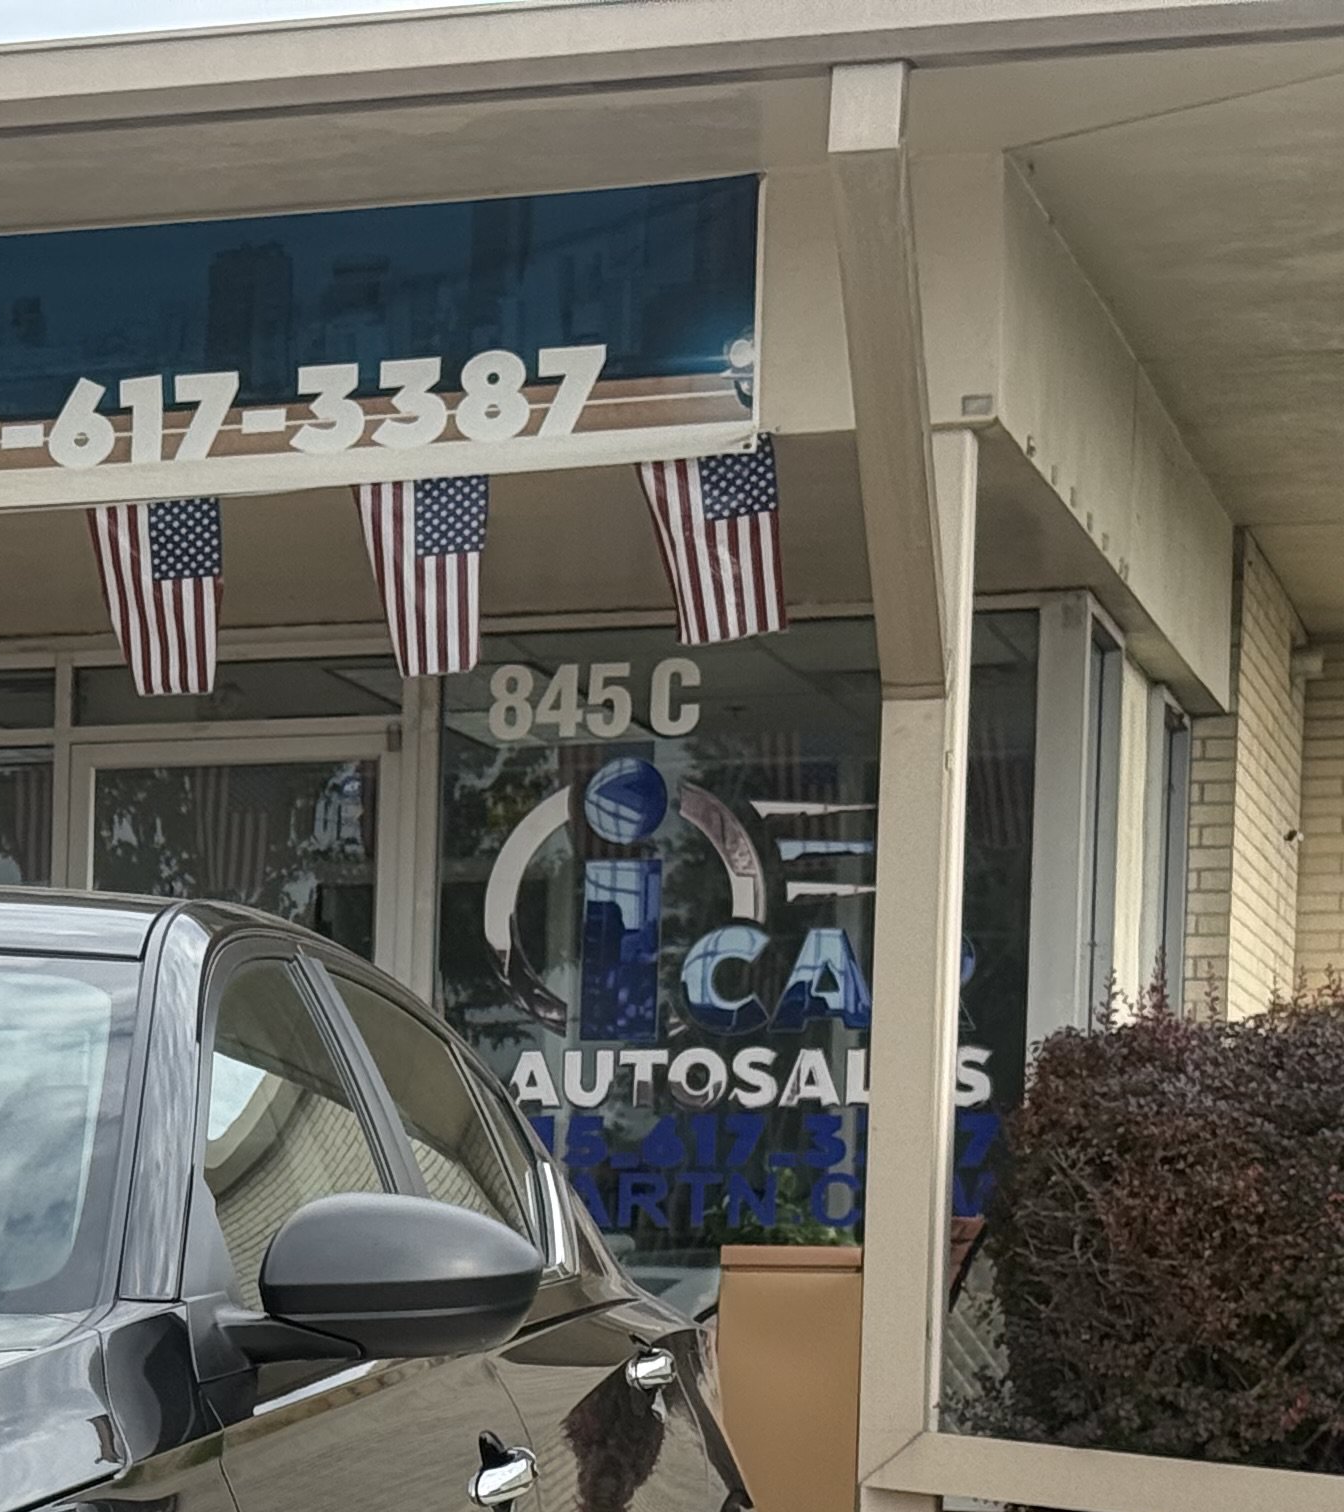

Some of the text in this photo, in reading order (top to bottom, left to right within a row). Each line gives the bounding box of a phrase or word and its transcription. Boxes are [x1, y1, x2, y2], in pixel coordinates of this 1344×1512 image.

[487, 657, 702, 741] 845 C
[511, 1045, 994, 1108] AUTOSALS
